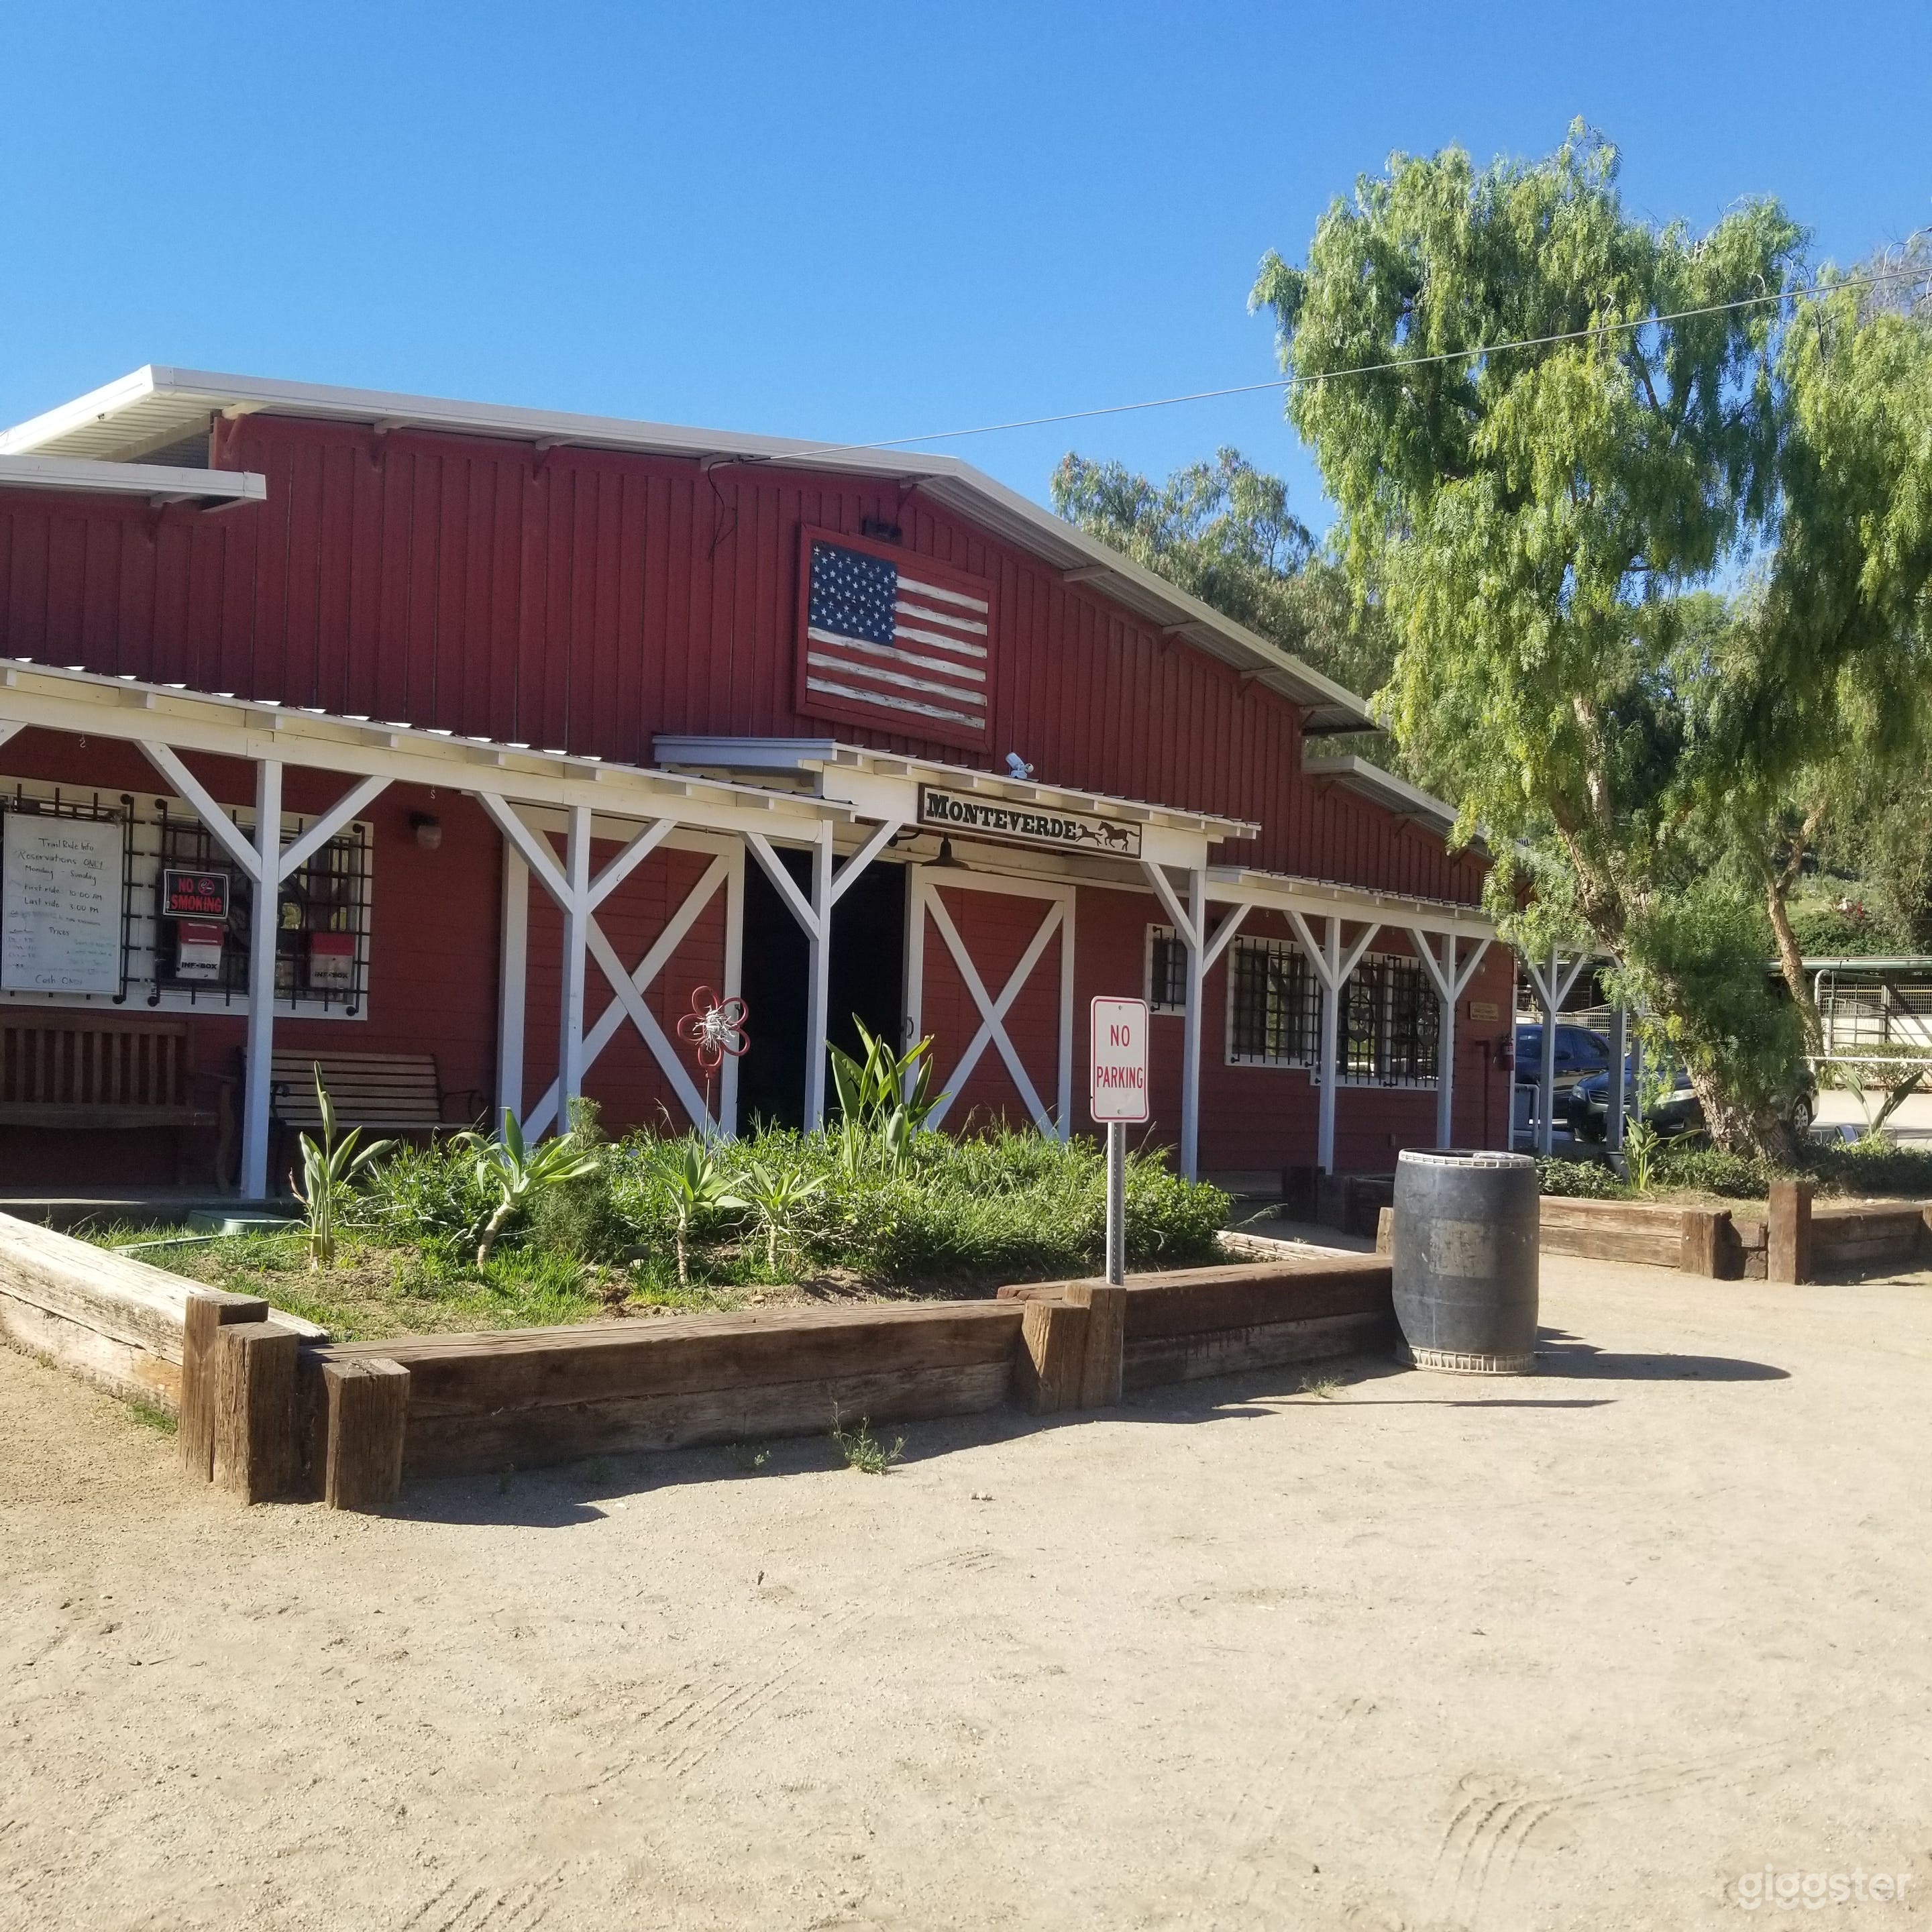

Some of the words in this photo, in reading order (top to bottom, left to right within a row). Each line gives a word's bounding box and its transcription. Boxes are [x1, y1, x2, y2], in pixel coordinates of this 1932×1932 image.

[926, 792, 1077, 841] MONTEVERDE
[38, 838, 60, 848] Trail
[63, 840, 78, 850] Ride
[81, 842, 94, 851] Info
[19, 851, 77, 865] Reservations
[25, 865, 54, 880] Monday
[70, 869, 97, 886] Sunday
[178, 877, 194, 893] NO
[24, 896, 41, 906] Last
[90, 906, 99, 914] PM
[171, 894, 223, 912] SMOKING
[48, 926, 70, 936] Prices
[35, 973, 56, 984] Cash
[1110, 1024, 1130, 1047] NO
[1096, 1065, 1144, 1089] PARKING
